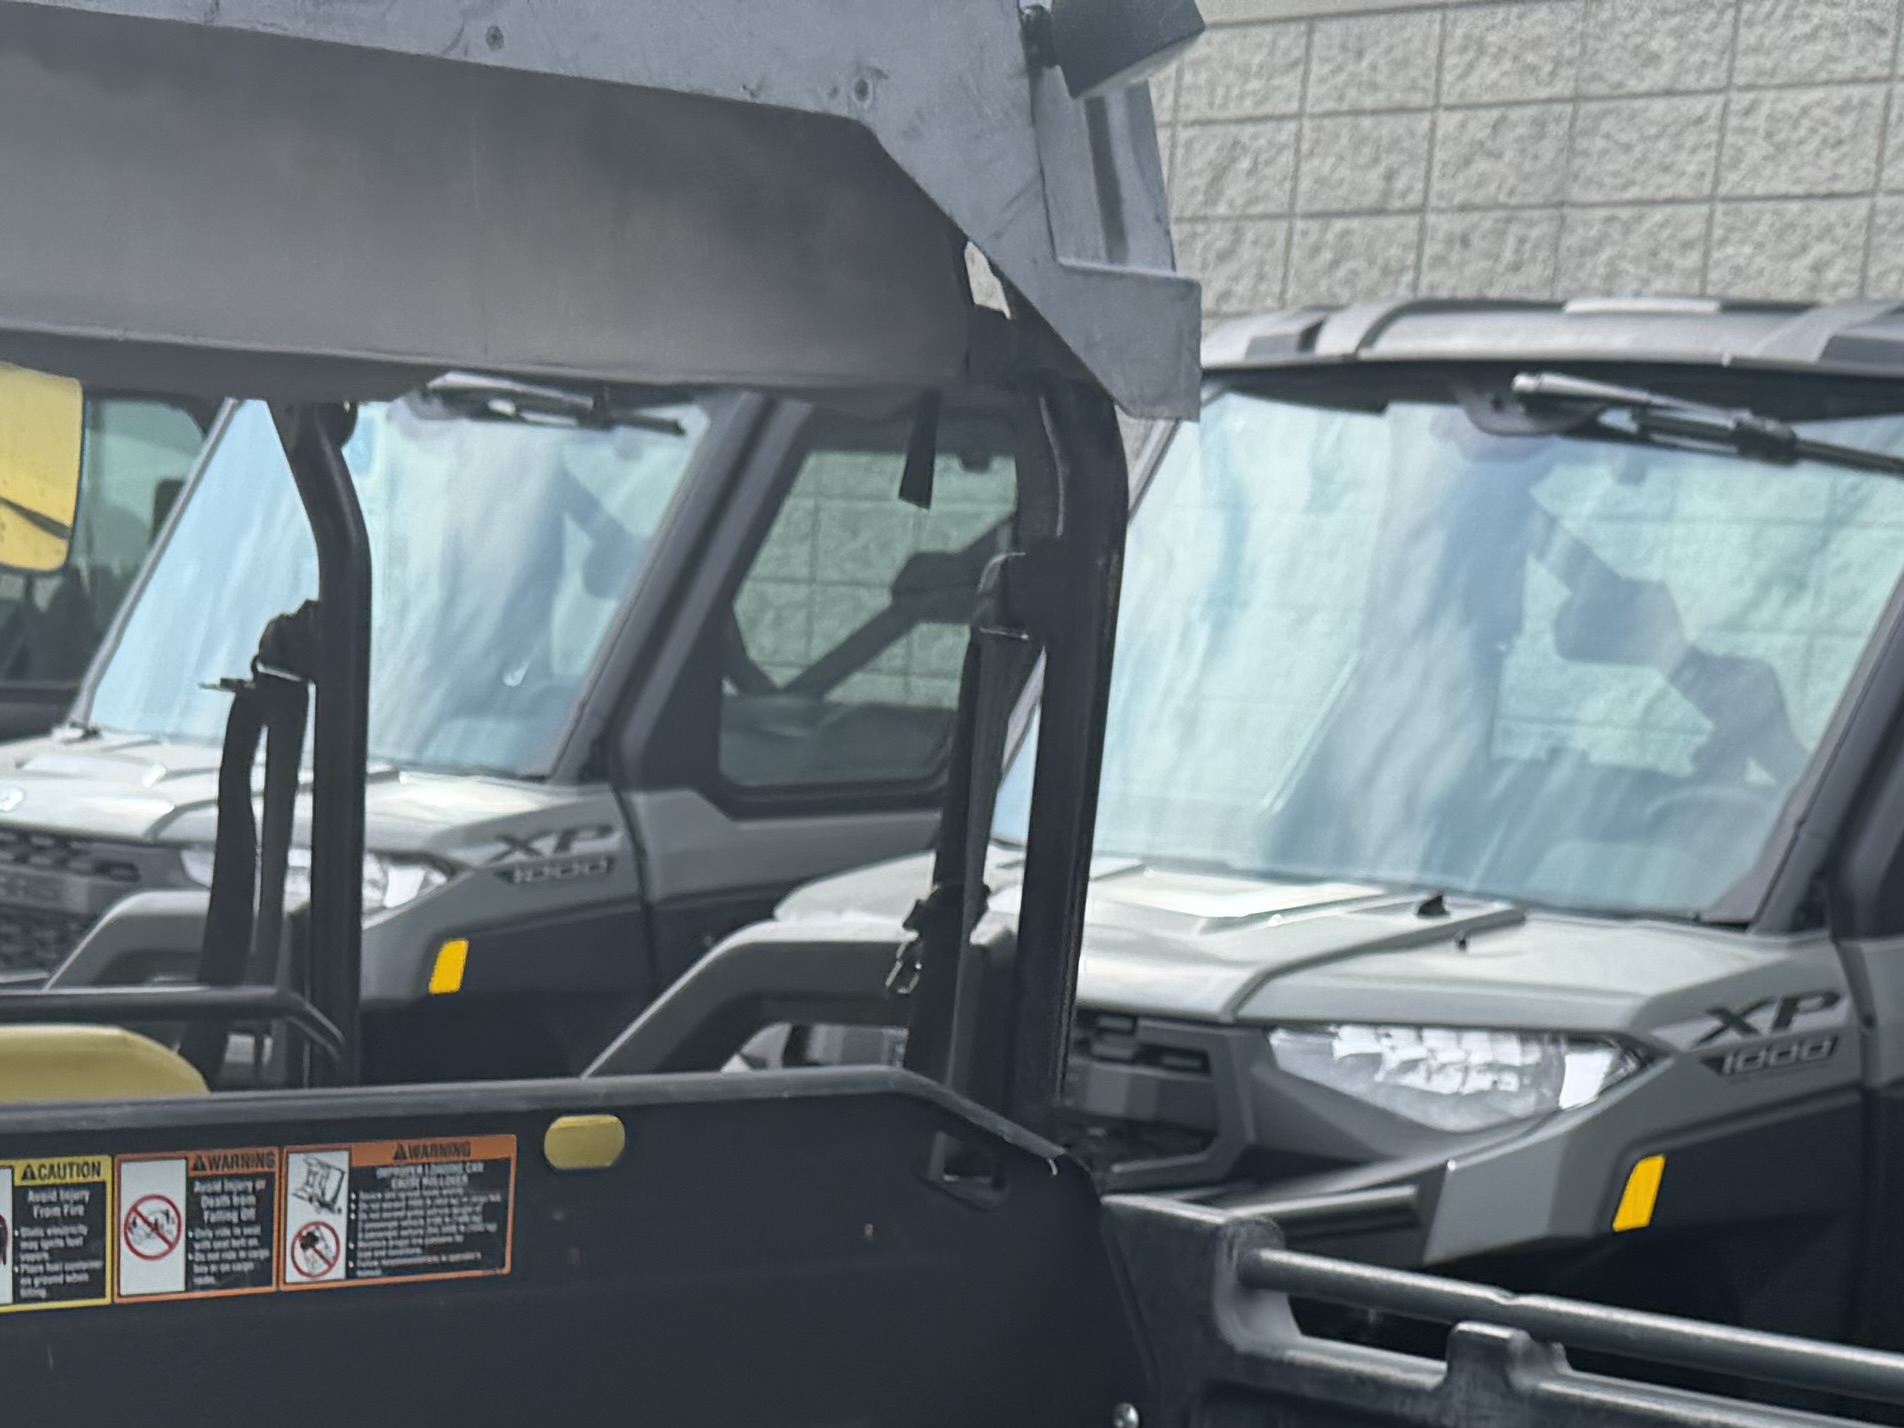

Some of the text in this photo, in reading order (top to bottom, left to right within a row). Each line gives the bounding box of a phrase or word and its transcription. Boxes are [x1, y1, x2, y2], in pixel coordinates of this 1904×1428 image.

[486, 824, 613, 864] XP
[1690, 990, 1841, 1050] XP
[1721, 1038, 1834, 1076] 1000
[209, 1152, 276, 1171] WARNING
[407, 1141, 472, 1160] WARNING
[38, 1161, 101, 1181] CAUTION
